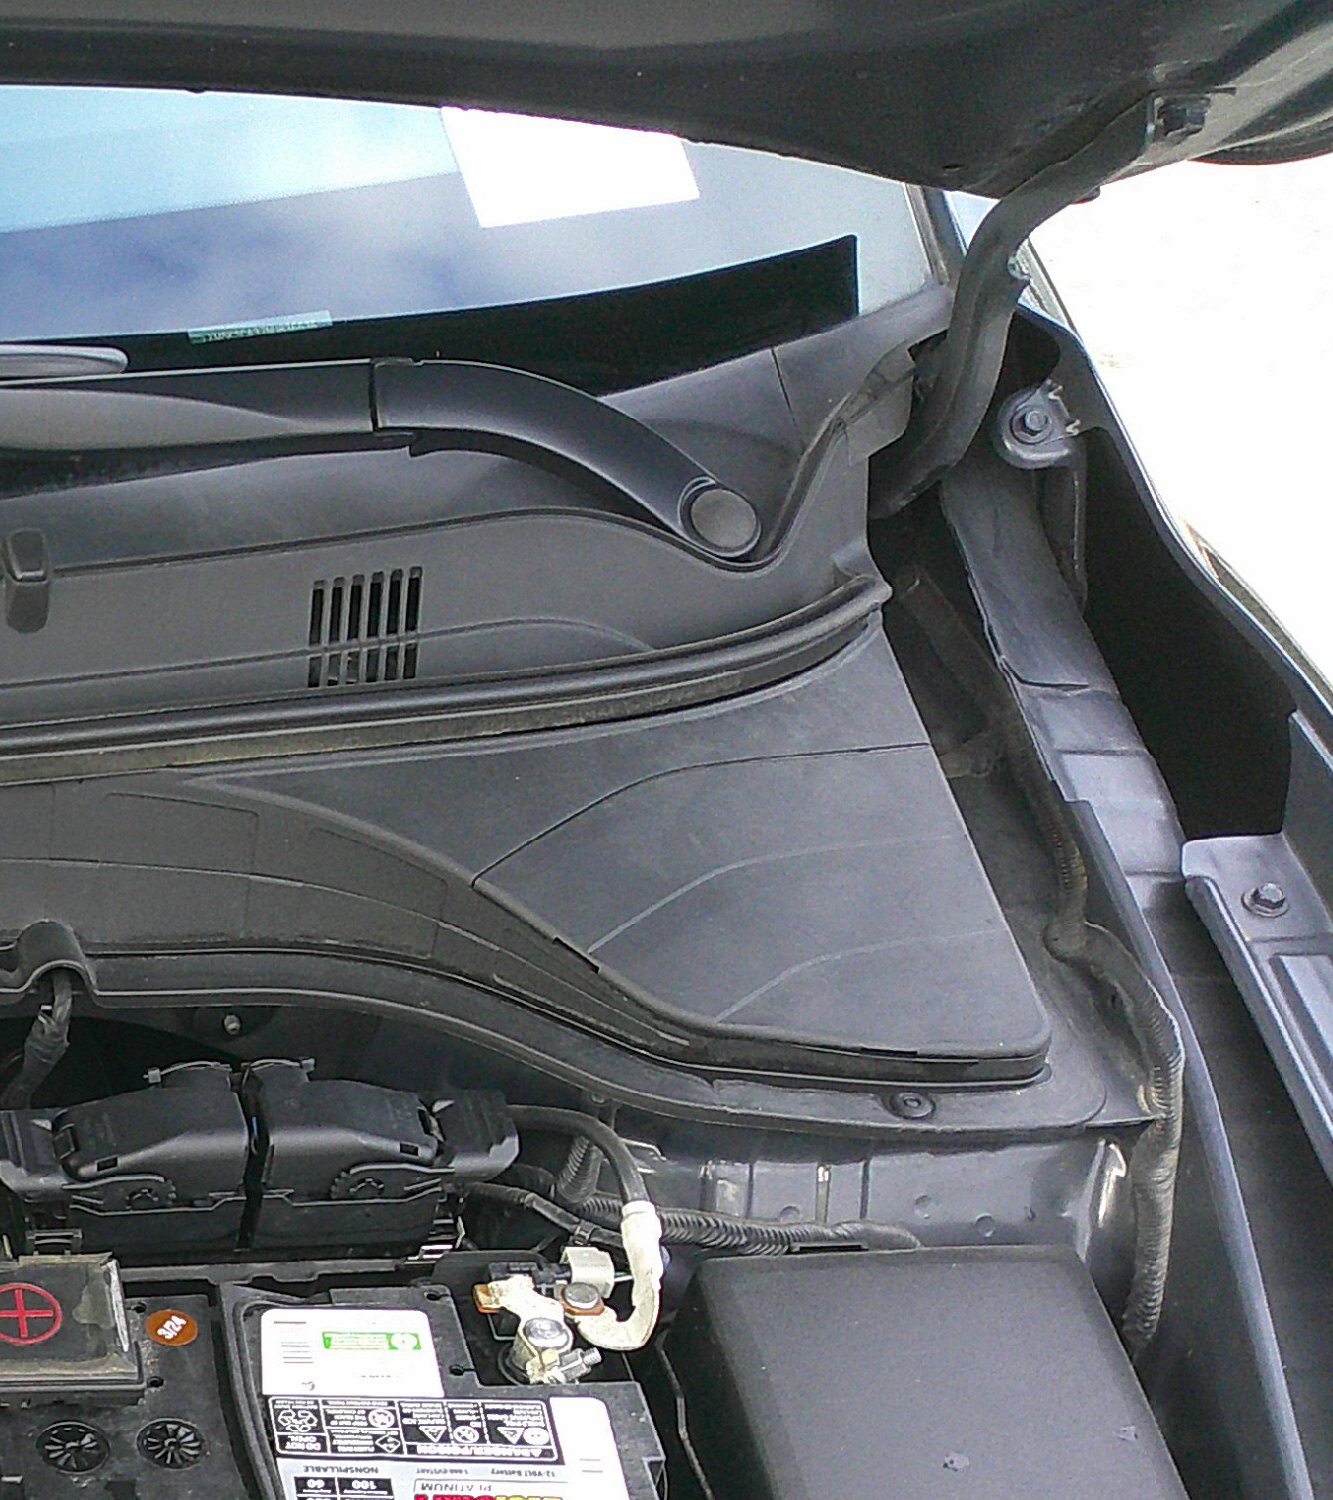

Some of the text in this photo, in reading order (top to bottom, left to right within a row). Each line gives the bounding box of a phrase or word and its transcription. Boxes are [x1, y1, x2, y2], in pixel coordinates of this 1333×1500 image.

[156, 1314, 188, 1340] 3/24
[302, 1464, 379, 1474] NONSPILLABLE
[490, 1467, 523, 1478] Battery
[306, 1478, 326, 1489] 60
[351, 1479, 378, 1490] 100
[420, 1482, 492, 1492] PLATINUM
